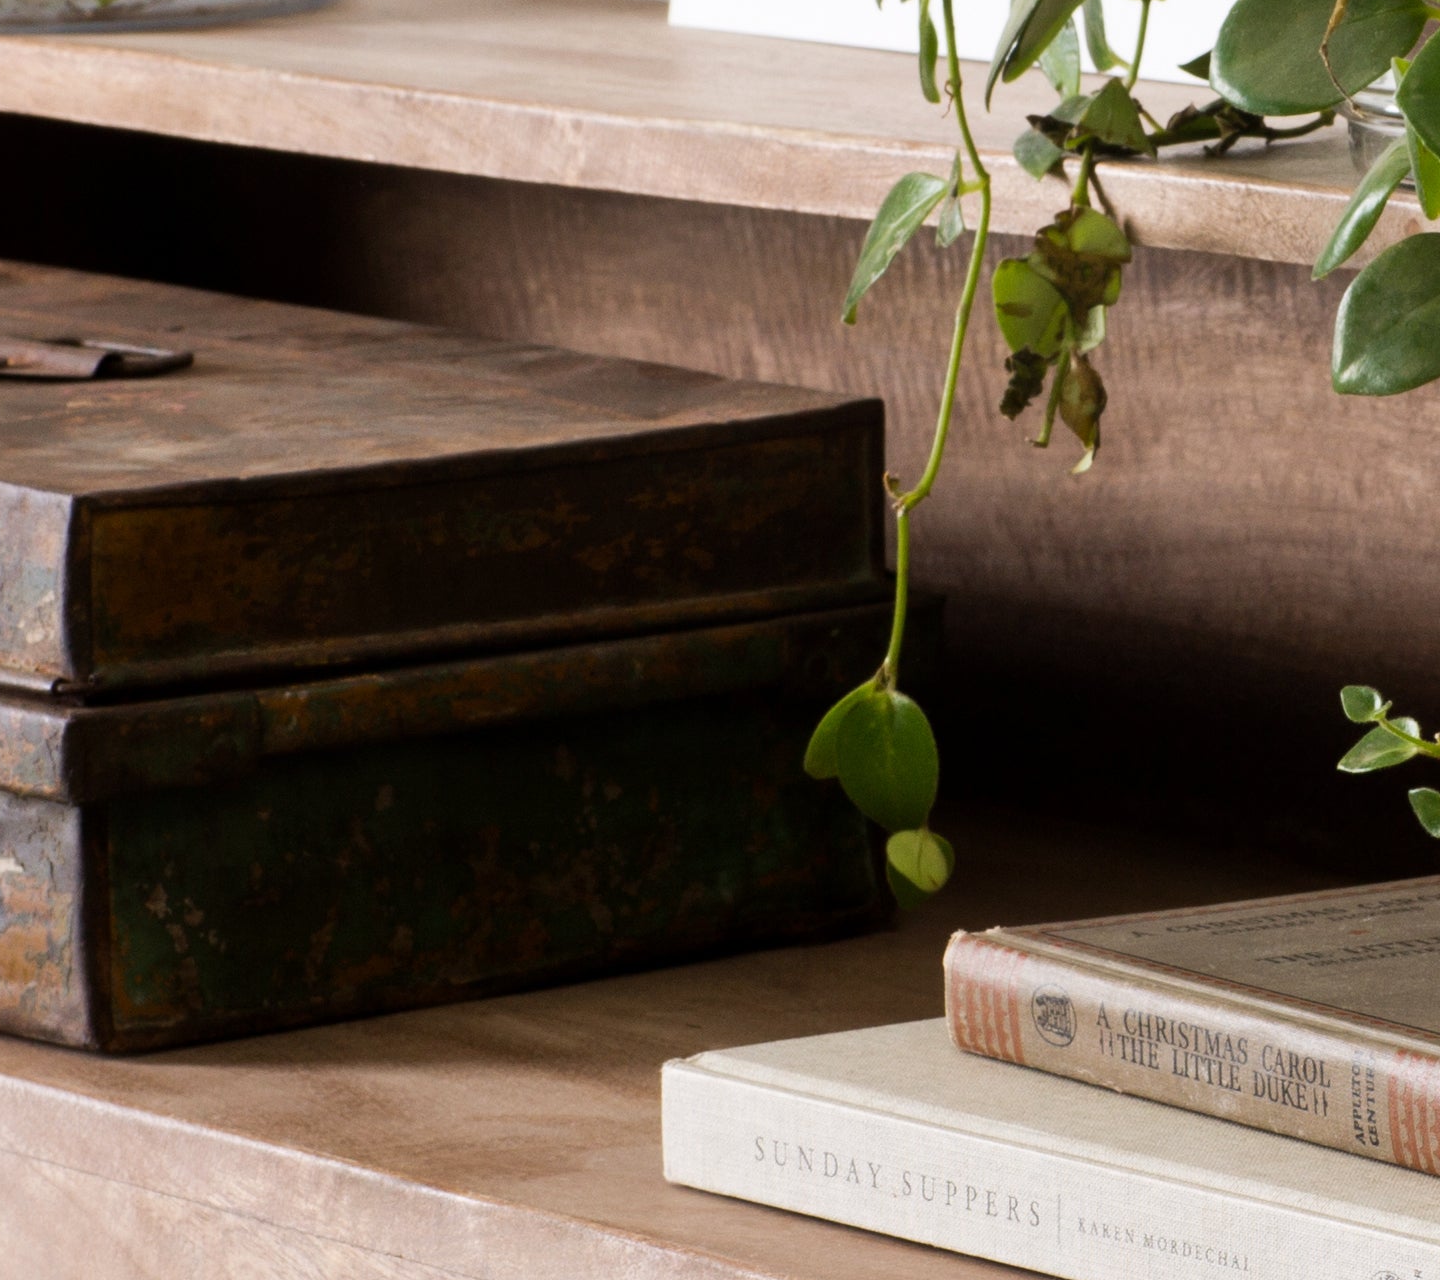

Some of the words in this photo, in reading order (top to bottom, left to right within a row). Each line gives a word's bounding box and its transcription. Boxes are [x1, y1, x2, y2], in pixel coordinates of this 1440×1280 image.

[1166, 906, 1347, 934] CHRISTMAS
[1255, 950, 1326, 965] THE
[1096, 1000, 1109, 1031] A
[1123, 1007, 1248, 1065] CHRISTMAS
[1261, 1044, 1331, 1089] CAROL
[1118, 1033, 1160, 1070] THE
[1172, 1051, 1241, 1093] LITTLE
[1253, 1070, 1308, 1113] DUKE
[754, 1135, 883, 1189] SUNDAY
[901, 1170, 1041, 1227] SUPPERS
[1077, 1217, 1135, 1244] KAREN
[1142, 1233, 1250, 1272] MORDECHAI
